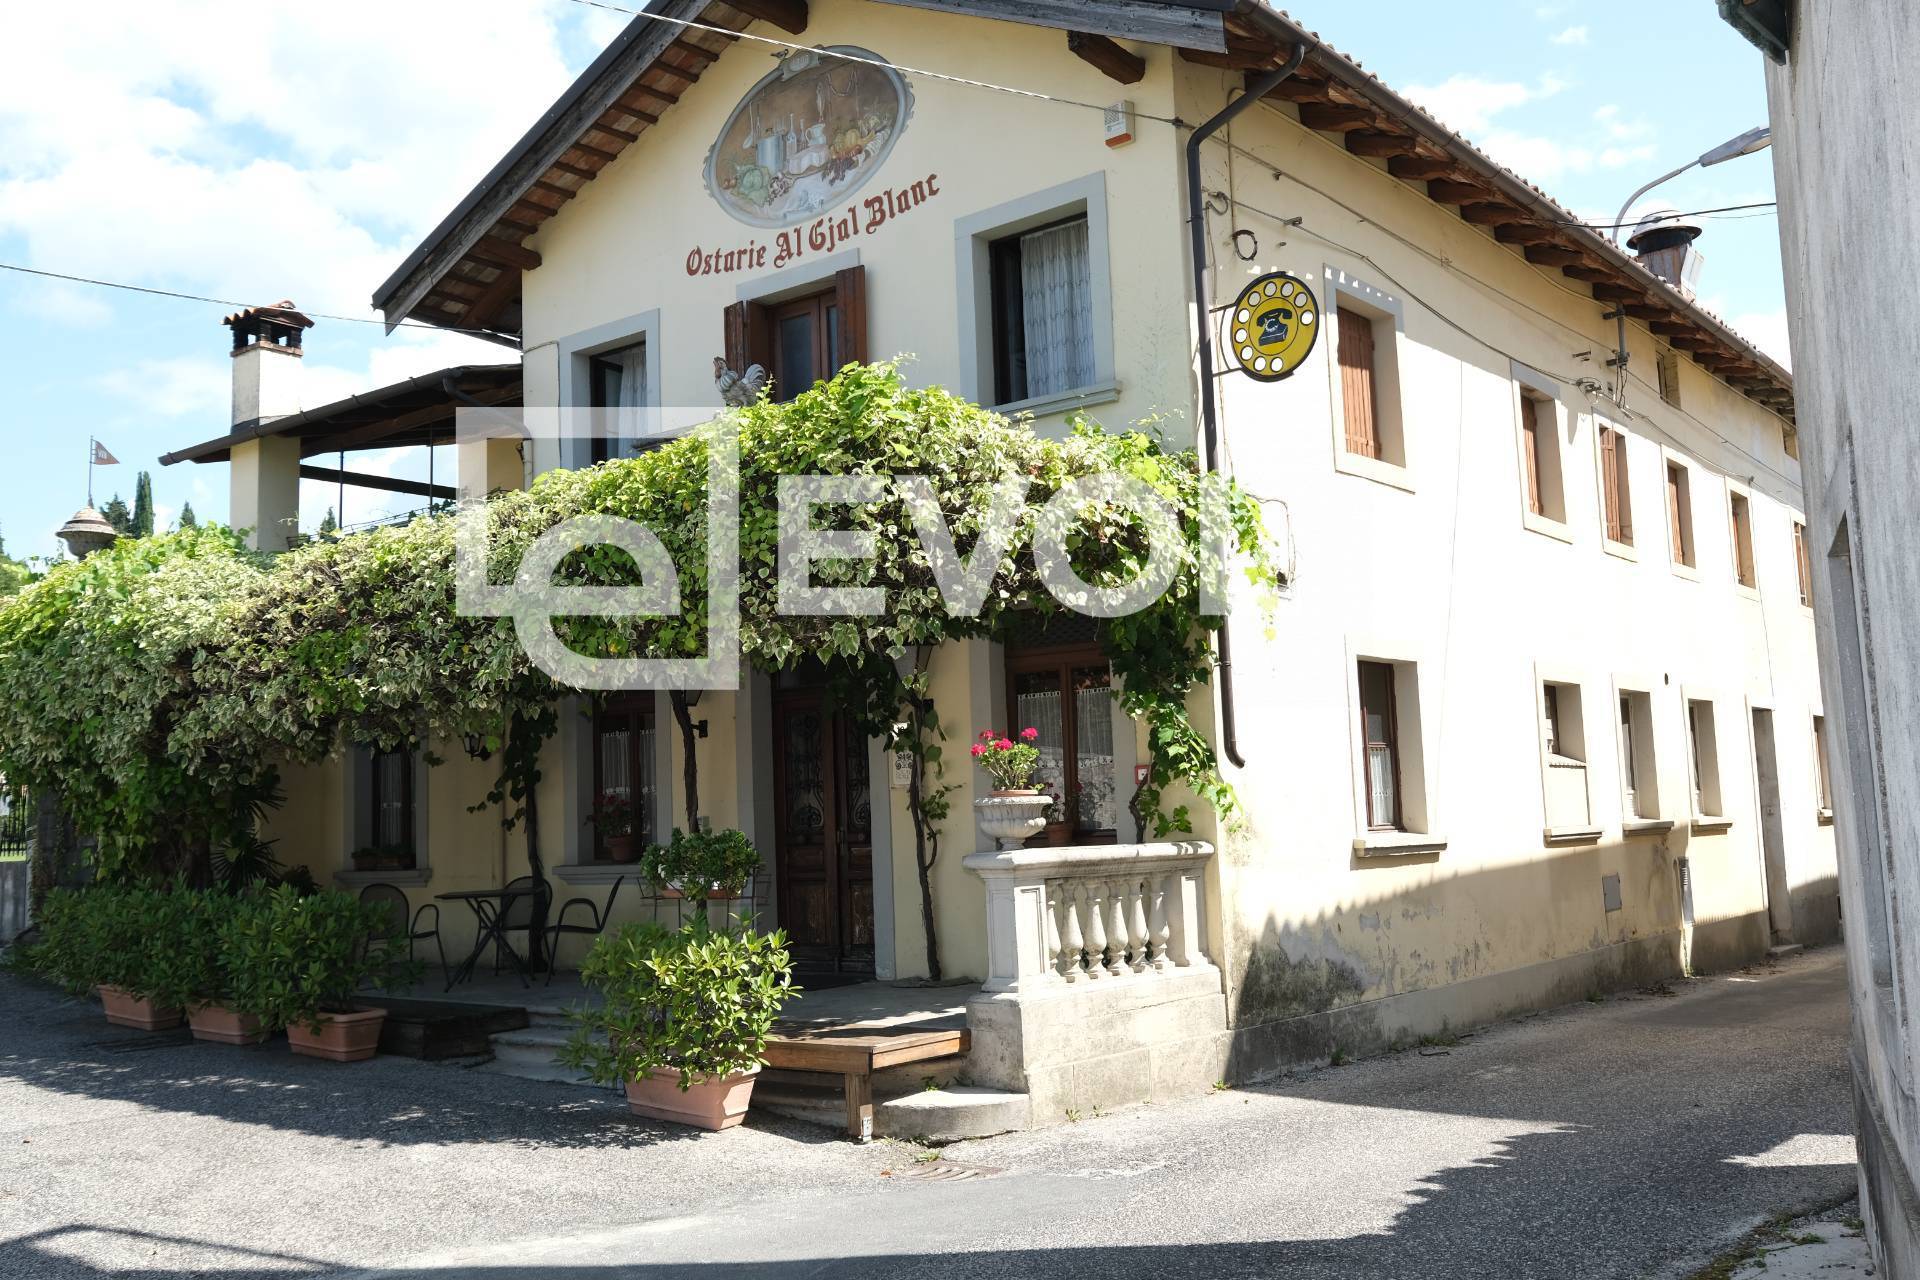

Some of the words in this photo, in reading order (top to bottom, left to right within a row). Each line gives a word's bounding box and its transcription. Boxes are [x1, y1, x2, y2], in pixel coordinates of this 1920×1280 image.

[686, 240, 767, 277] Ostarie
[774, 226, 802, 269] Al
[808, 205, 860, 253] Gjal
[864, 173, 941, 235] Blanc
